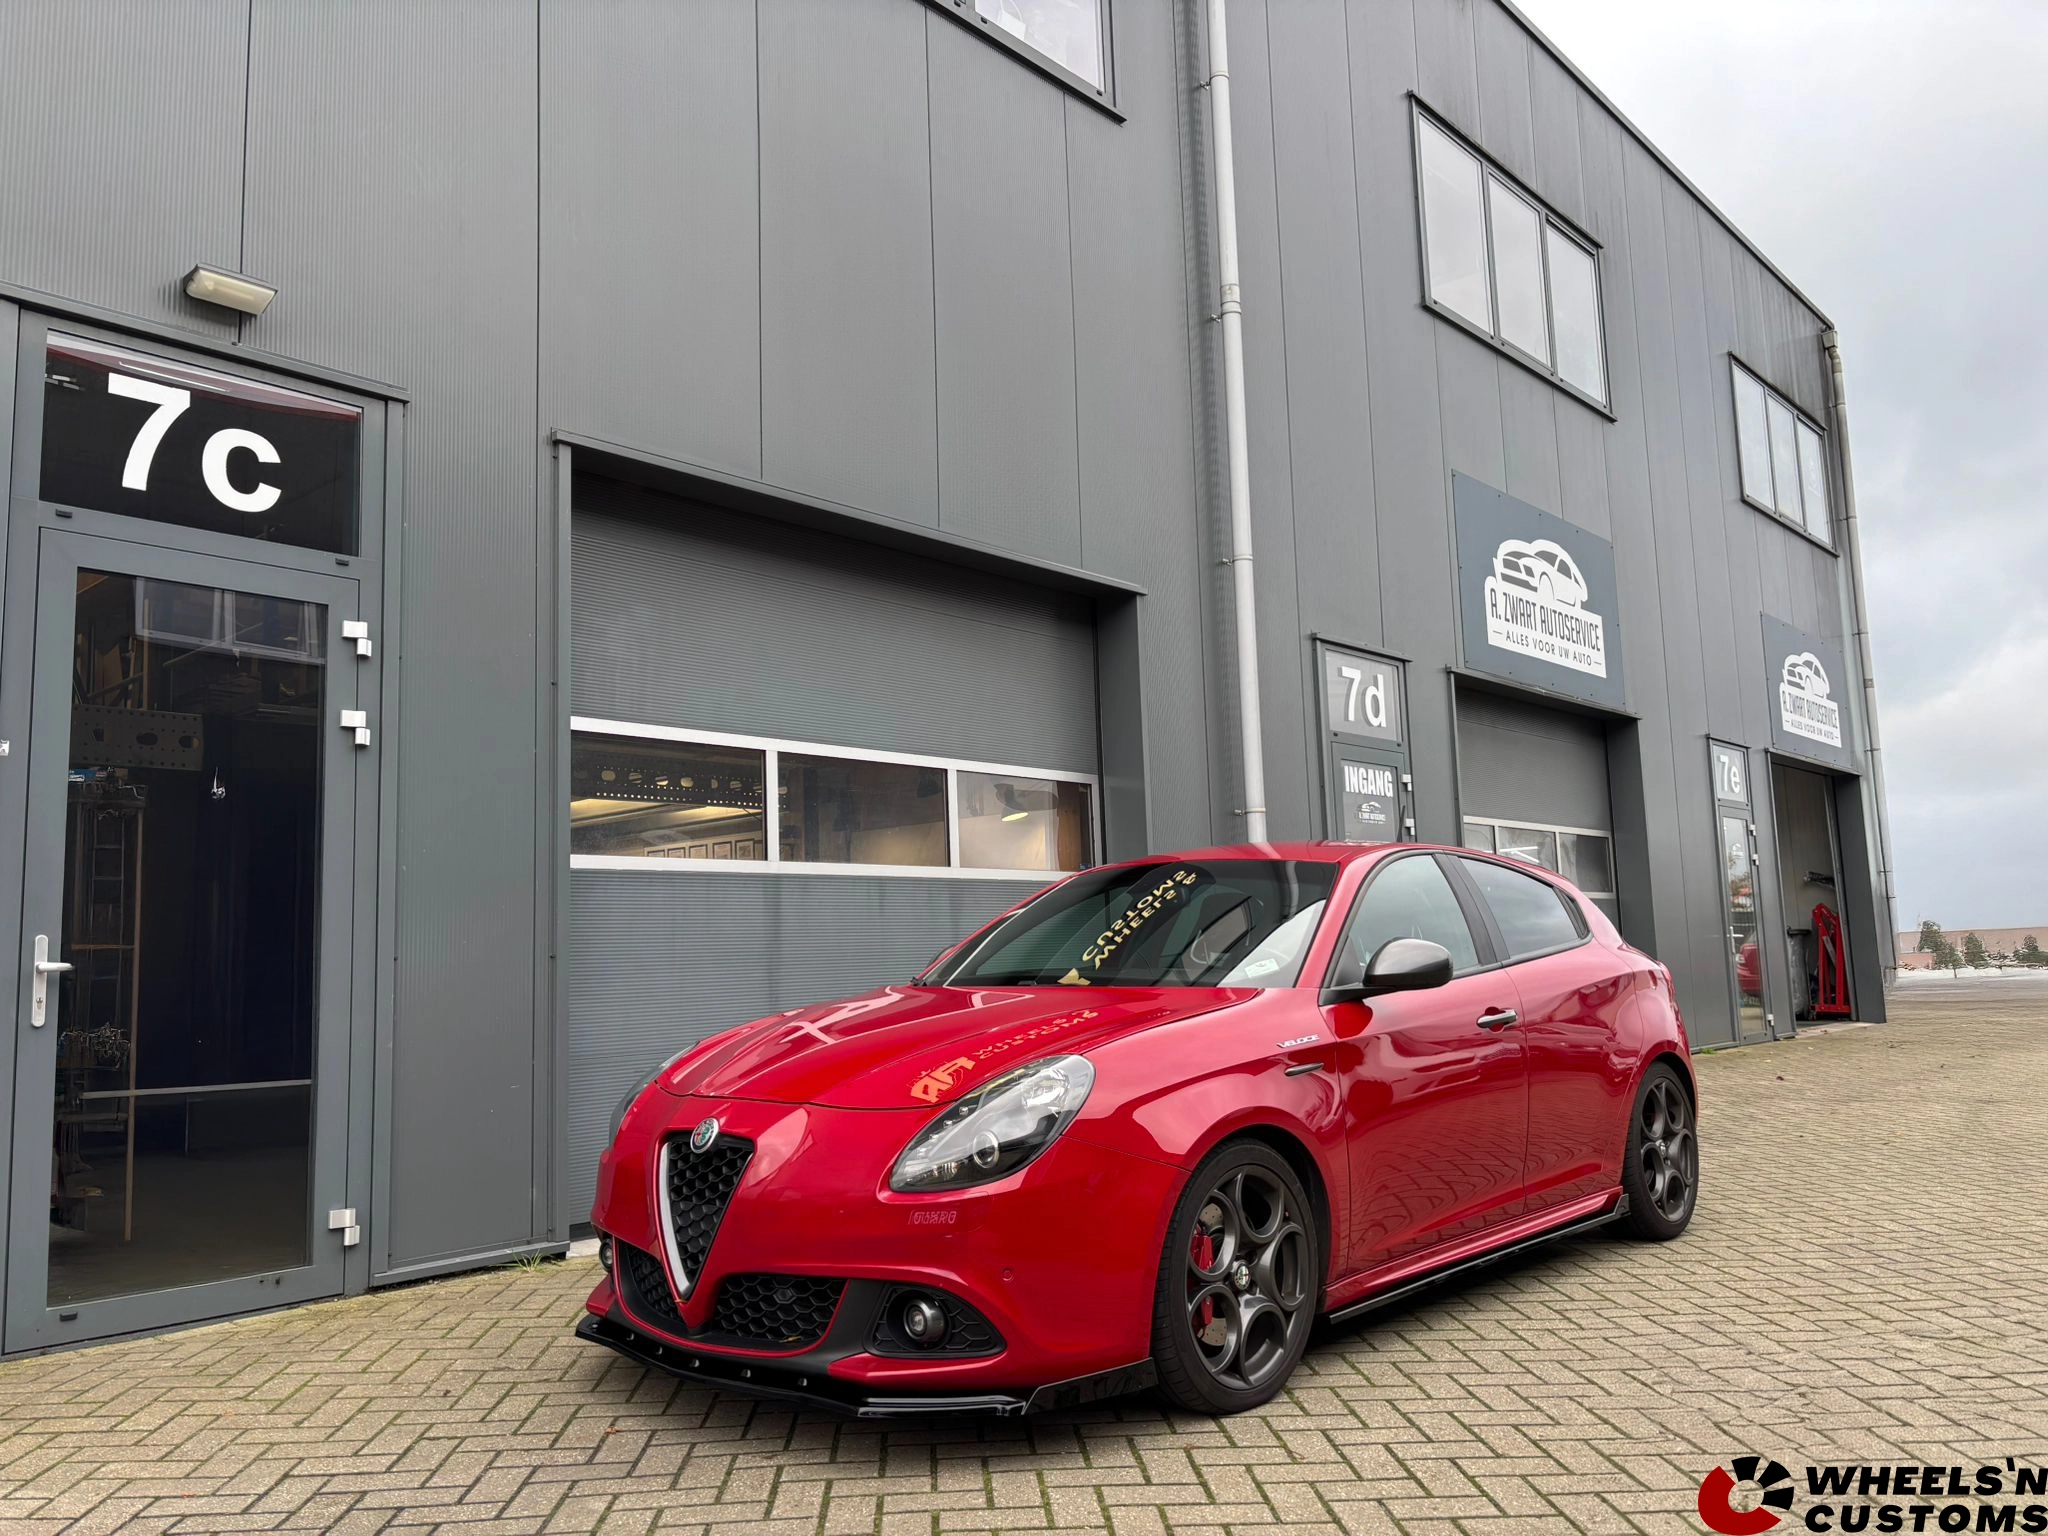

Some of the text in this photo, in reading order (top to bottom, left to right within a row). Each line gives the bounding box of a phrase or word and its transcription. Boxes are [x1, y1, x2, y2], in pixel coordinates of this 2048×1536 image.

[107, 372, 282, 513] 7c
[1490, 587, 1601, 652] A. ZWART AUTOSERVICE
[1506, 630, 1592, 666] ALLES VOOR UW AUTO
[1341, 666, 1387, 728] 7d
[1343, 765, 1394, 798] INGANG
[1719, 754, 1741, 794] 7e
[1276, 1034, 1321, 1048] VELOCE
